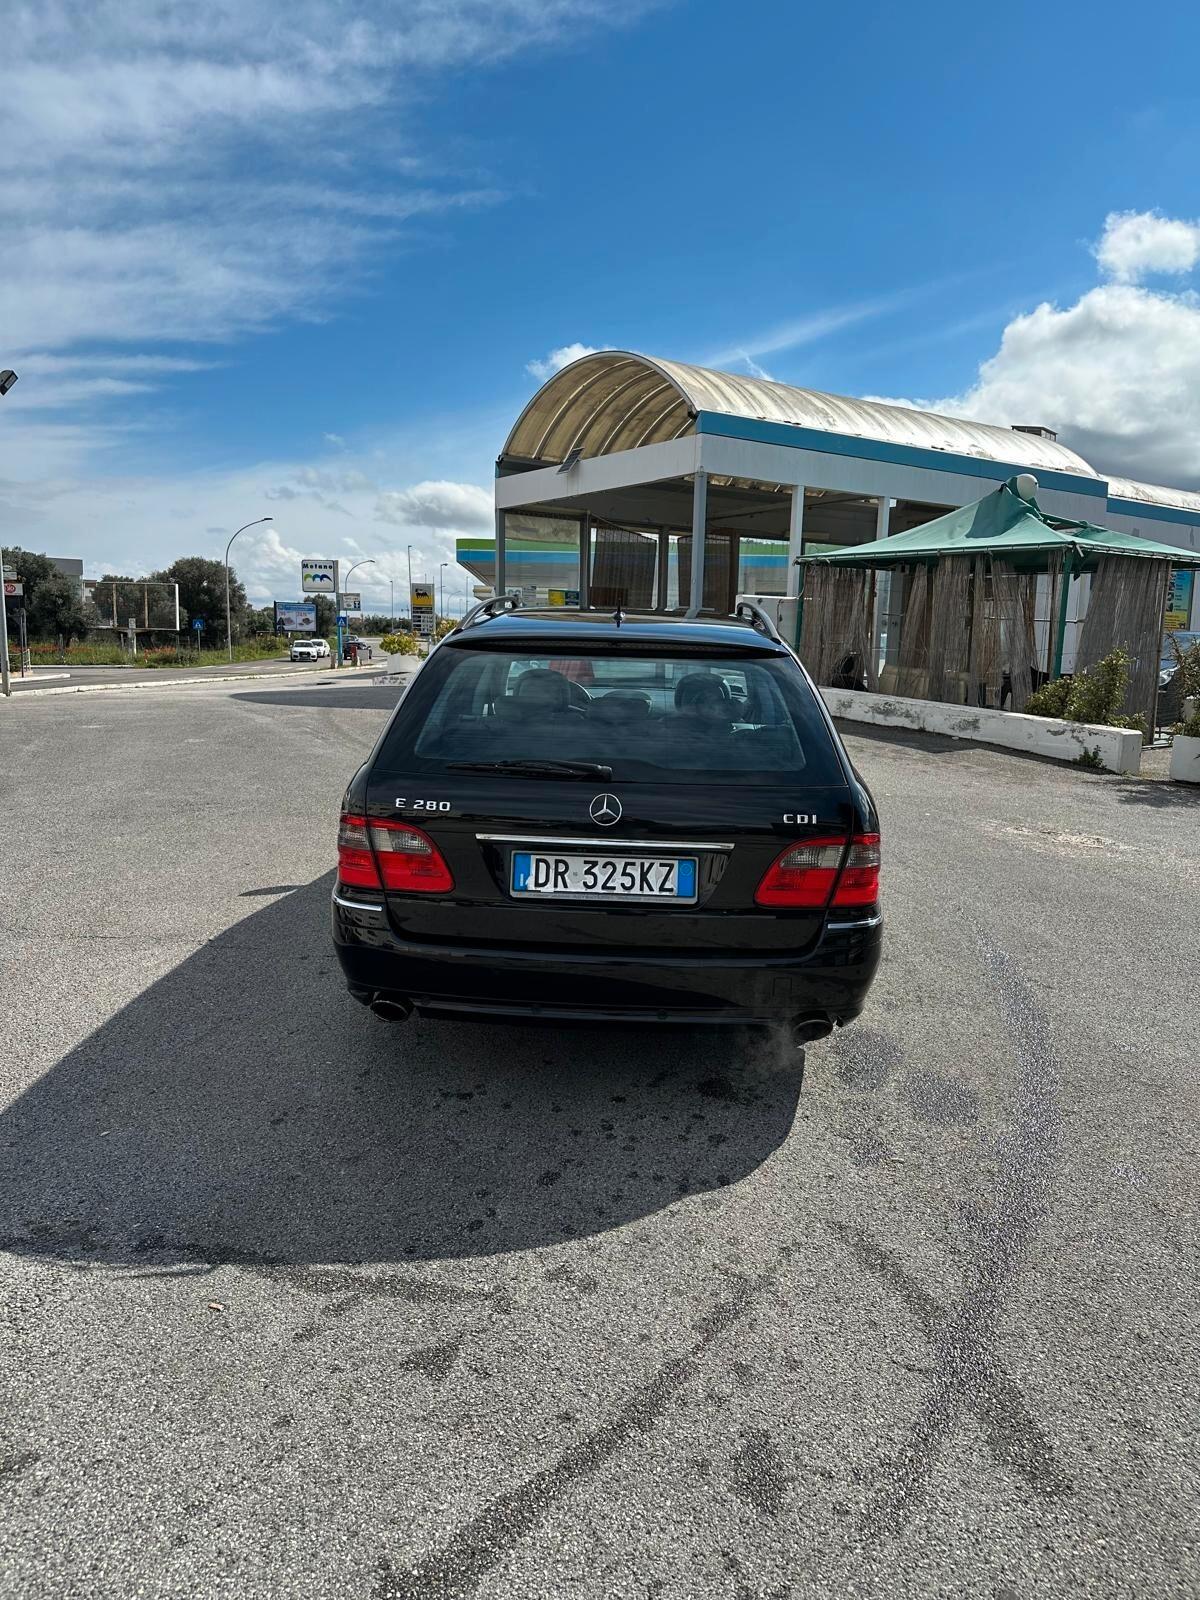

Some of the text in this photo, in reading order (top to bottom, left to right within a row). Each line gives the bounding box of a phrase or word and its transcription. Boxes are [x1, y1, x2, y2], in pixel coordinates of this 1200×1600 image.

[395, 797, 450, 811] E 280
[783, 813, 817, 824] CDI
[534, 857, 676, 893] DR 325KZ
